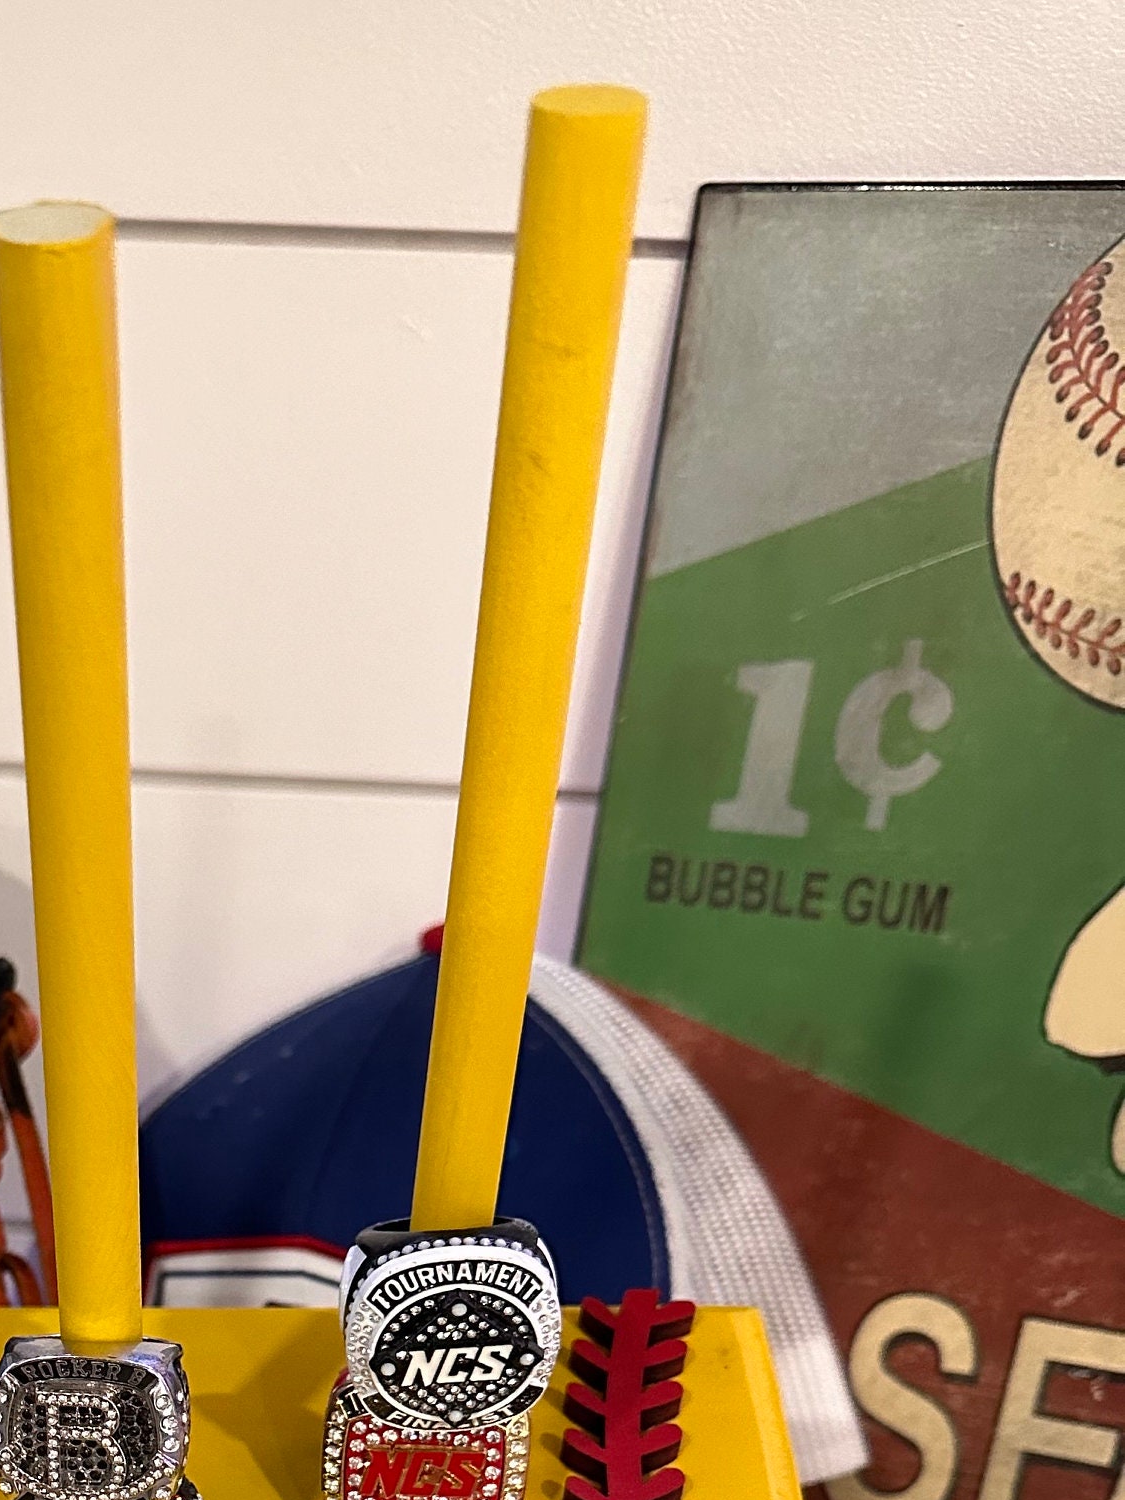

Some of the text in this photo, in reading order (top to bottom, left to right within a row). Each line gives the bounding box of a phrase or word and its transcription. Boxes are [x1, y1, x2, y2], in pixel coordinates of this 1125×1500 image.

[645, 854, 953, 934] BUBBLE GUM
[371, 1261, 544, 1311] TOURNAMENT
[23, 1358, 122, 1383] ROCKER
[400, 1344, 514, 1388] NCS
[359, 1446, 488, 1498] NCS
